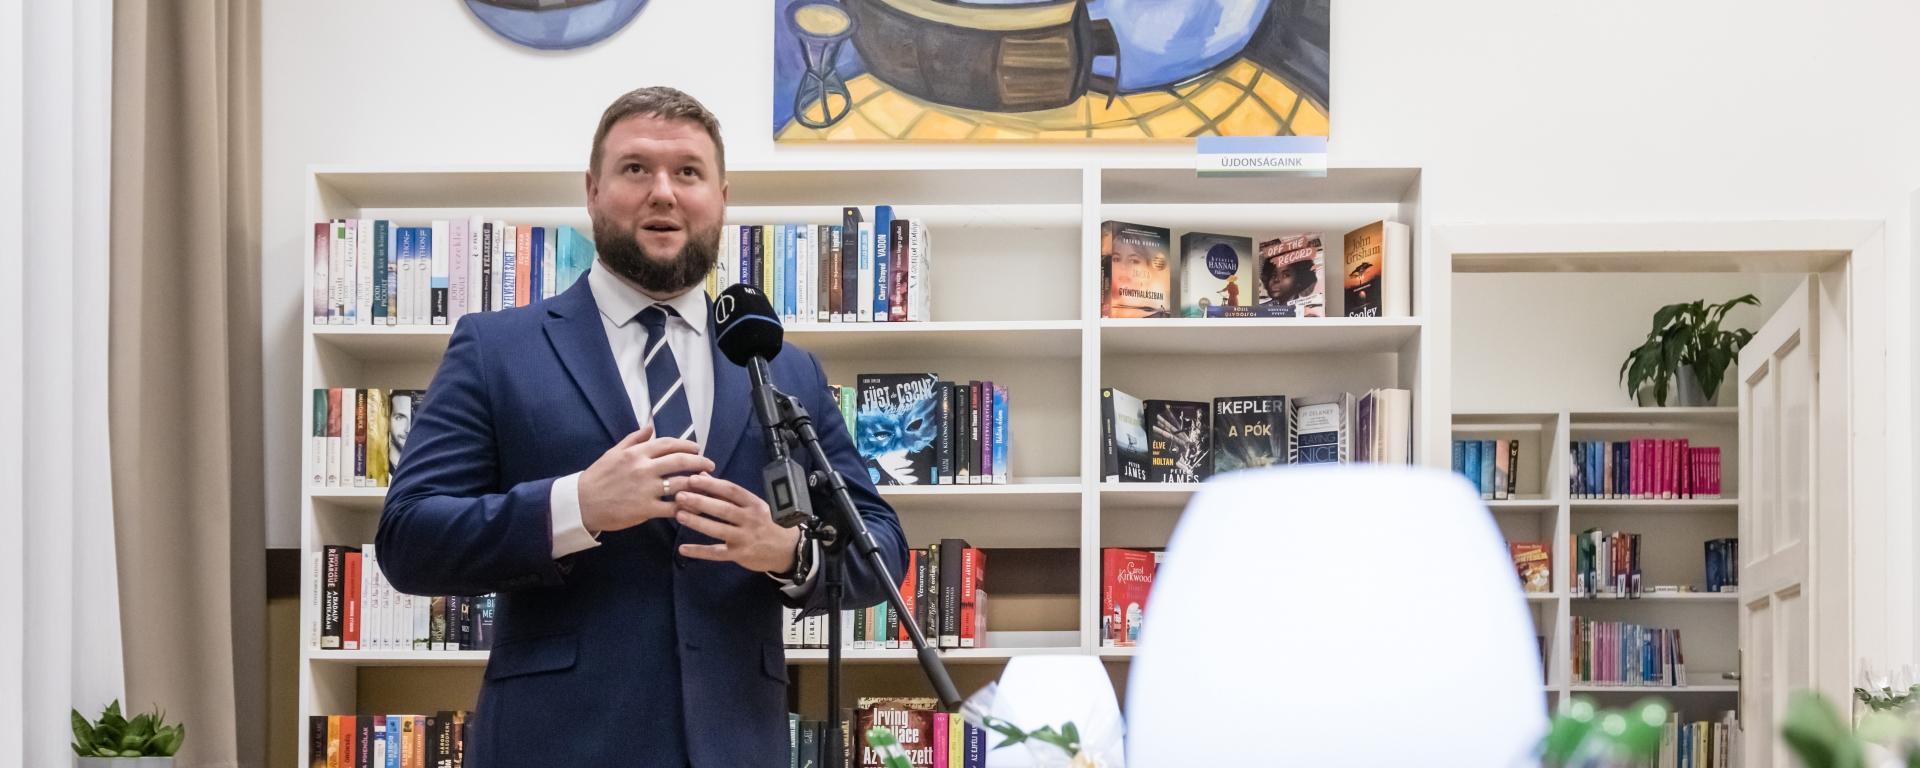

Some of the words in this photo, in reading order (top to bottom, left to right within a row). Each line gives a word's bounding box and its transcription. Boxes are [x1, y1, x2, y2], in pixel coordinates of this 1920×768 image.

[1221, 157, 1302, 167] ÚJDONSÁGAINK
[877, 234, 886, 258] VADON
[1267, 244, 1284, 256] OFF
[1287, 237, 1305, 251] THE
[1352, 235, 1371, 252] John
[504, 252, 514, 270] SZIGET
[1278, 248, 1313, 266] RECORD
[1346, 245, 1380, 265] Grisham
[878, 263, 887, 282] Strayed
[1208, 261, 1237, 270] HANNAH
[504, 272, 514, 300] ELVESZETT
[878, 283, 887, 300] Cheryl
[862, 386, 890, 411] FÜST
[1222, 400, 1283, 414] KEPLER
[1228, 427, 1238, 438] A
[1244, 421, 1272, 437] PÓK
[1152, 440, 1166, 450] ÉLVE
[1300, 434, 1336, 445] PLAYING
[1152, 458, 1174, 466] HOLTAN
[1300, 448, 1336, 462] NICE
[1124, 465, 1146, 481] JAMES
[1161, 473, 1200, 484] JAMES
[328, 548, 336, 588] REMARQUE
[1117, 569, 1152, 584] Kirkwood
[1127, 562, 1144, 575] Carol
[873, 707, 909, 728] Irving
[863, 747, 879, 764] Az
